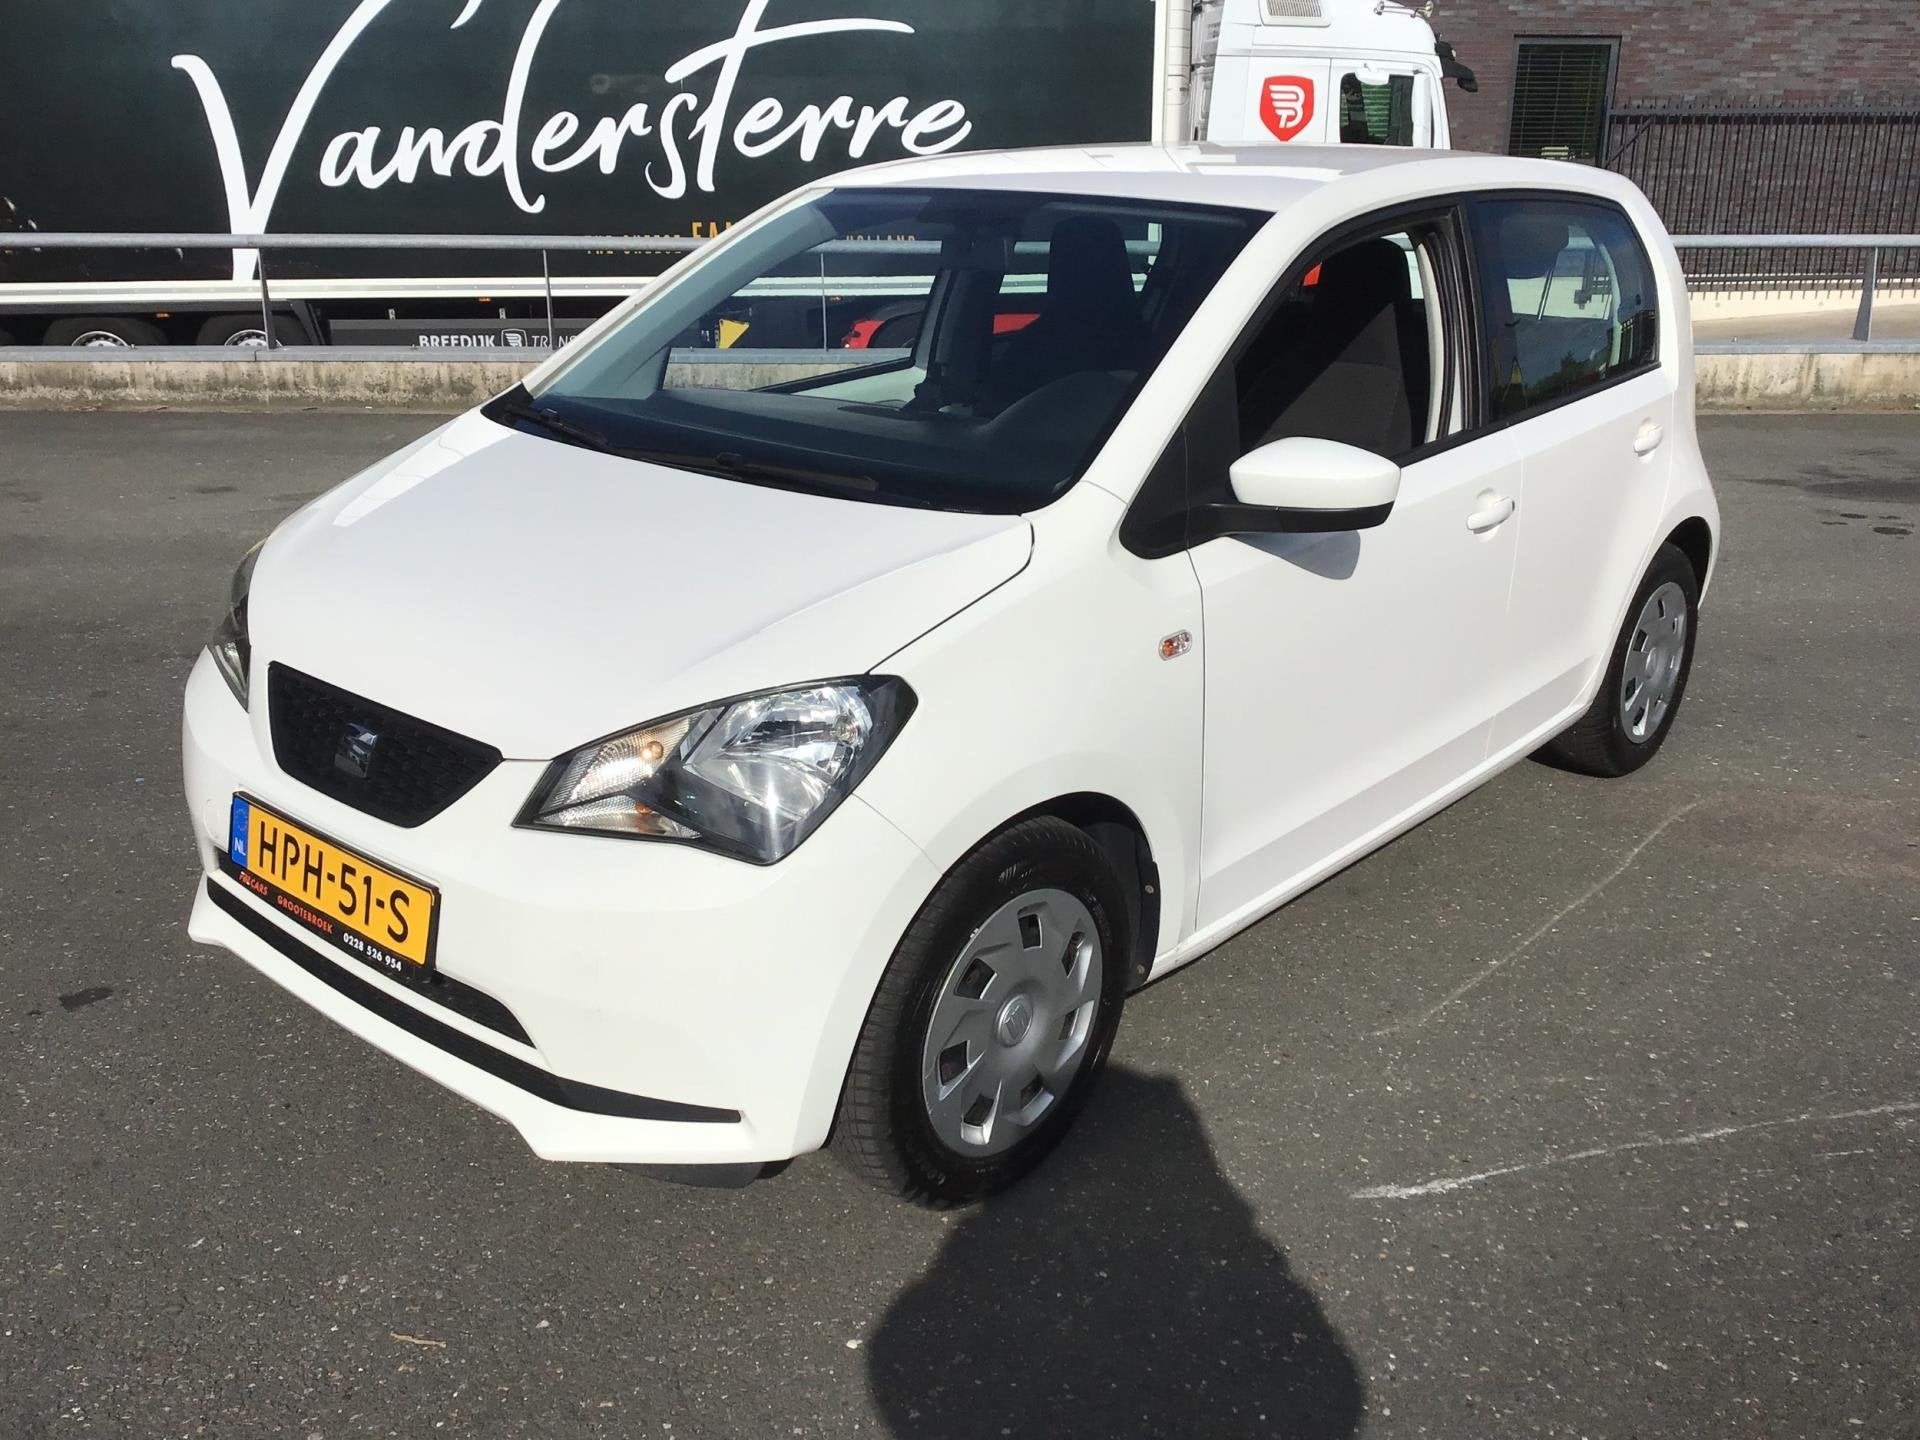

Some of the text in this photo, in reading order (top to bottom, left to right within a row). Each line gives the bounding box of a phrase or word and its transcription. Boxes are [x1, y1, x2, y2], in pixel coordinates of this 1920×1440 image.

[171, 0, 973, 281] Vandersterre
[418, 335, 577, 348] BREEDIJK TRN
[234, 836, 246, 856] NL
[259, 820, 410, 944] HPH-51-S
[277, 895, 334, 935] GROOTEBROEK
[343, 932, 364, 952] 0228
[366, 945, 383, 962] 526
[385, 955, 402, 972] 954
